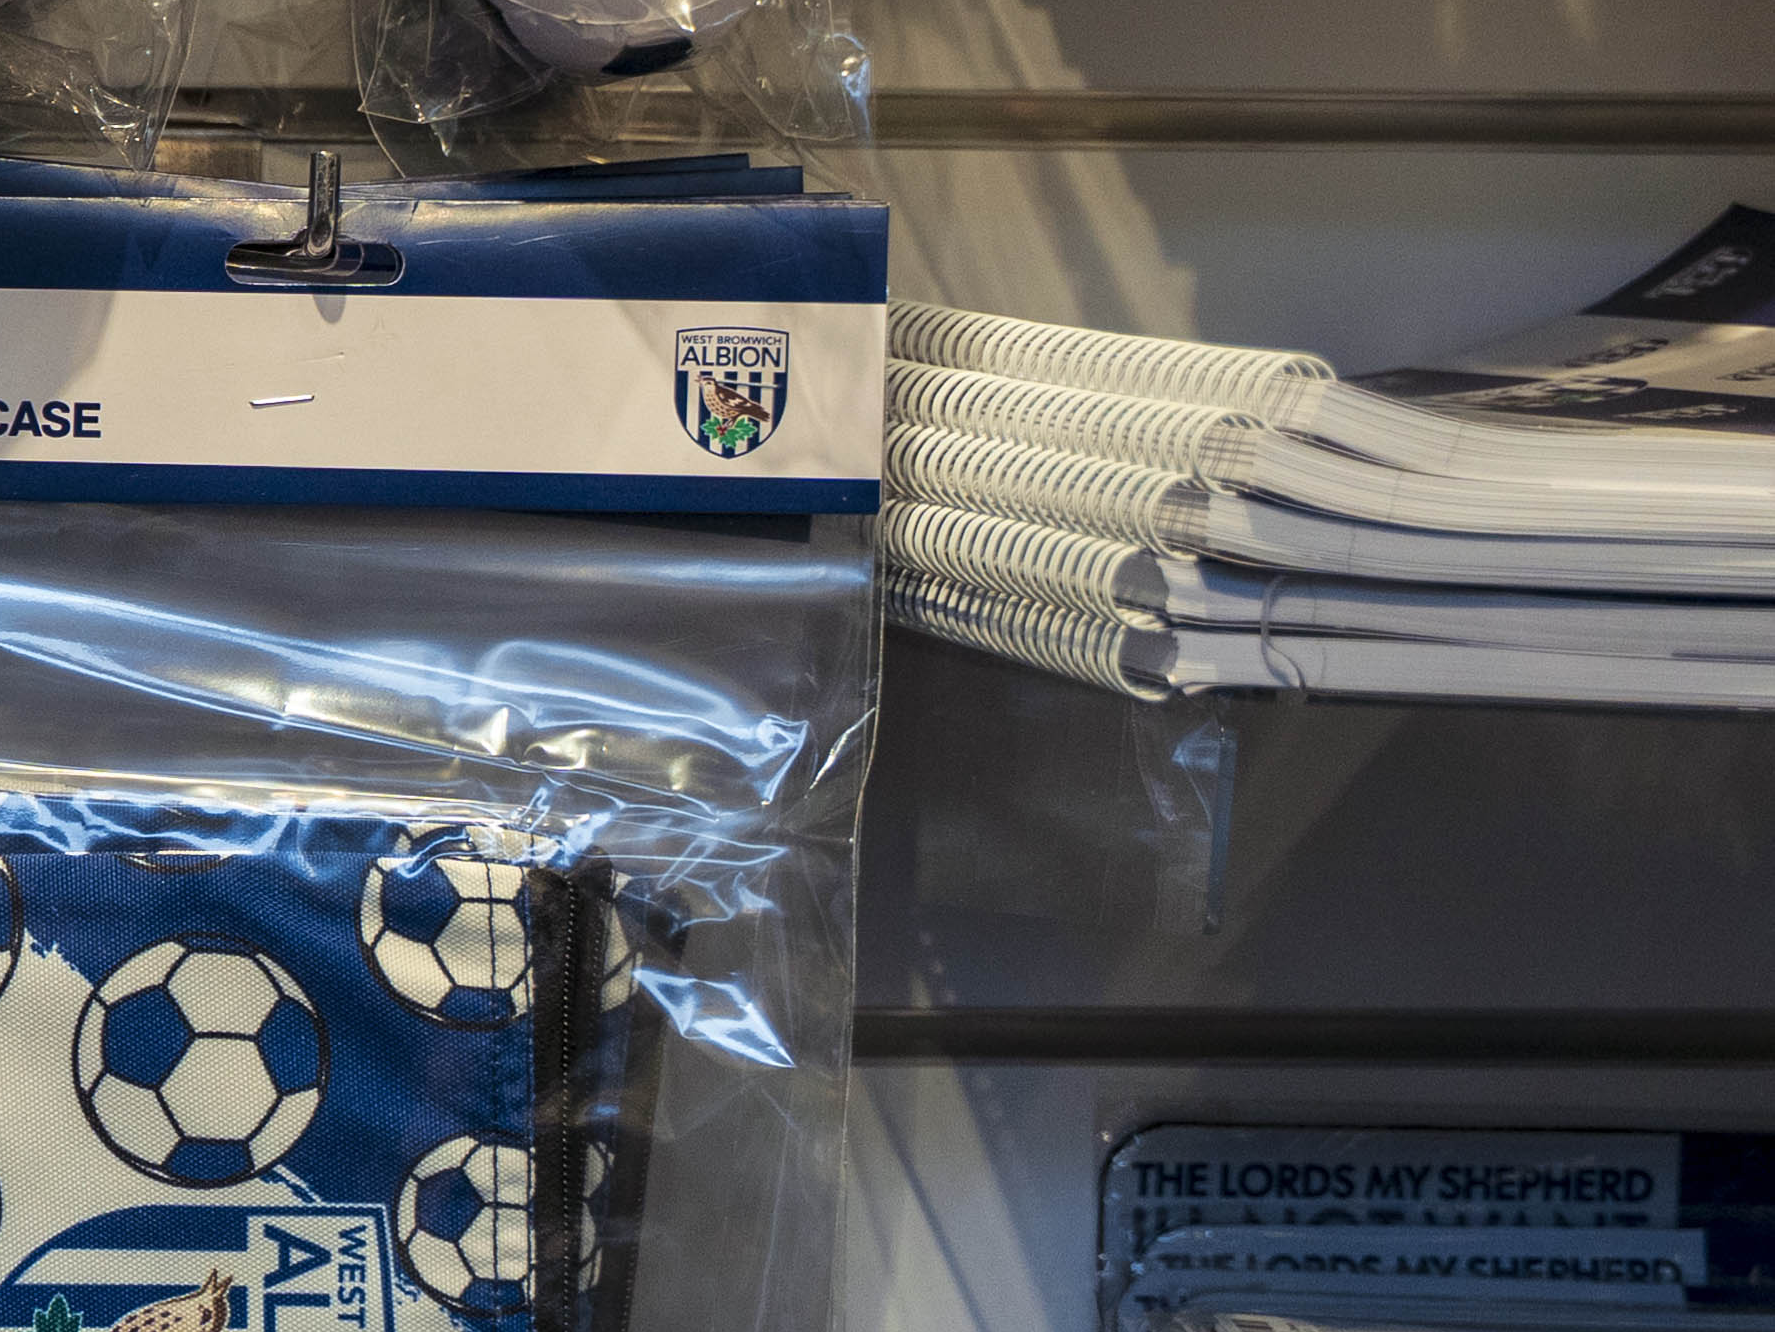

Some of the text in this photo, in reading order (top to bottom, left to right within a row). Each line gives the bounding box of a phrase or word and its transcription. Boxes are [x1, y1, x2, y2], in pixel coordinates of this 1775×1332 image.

[681, 335, 782, 346] WEST BROMWICH
[681, 346, 781, 368] ALBION
[1133, 1162, 1652, 1204] THE LORDS MY SHEPHERD
[338, 1225, 366, 1328] WEST
